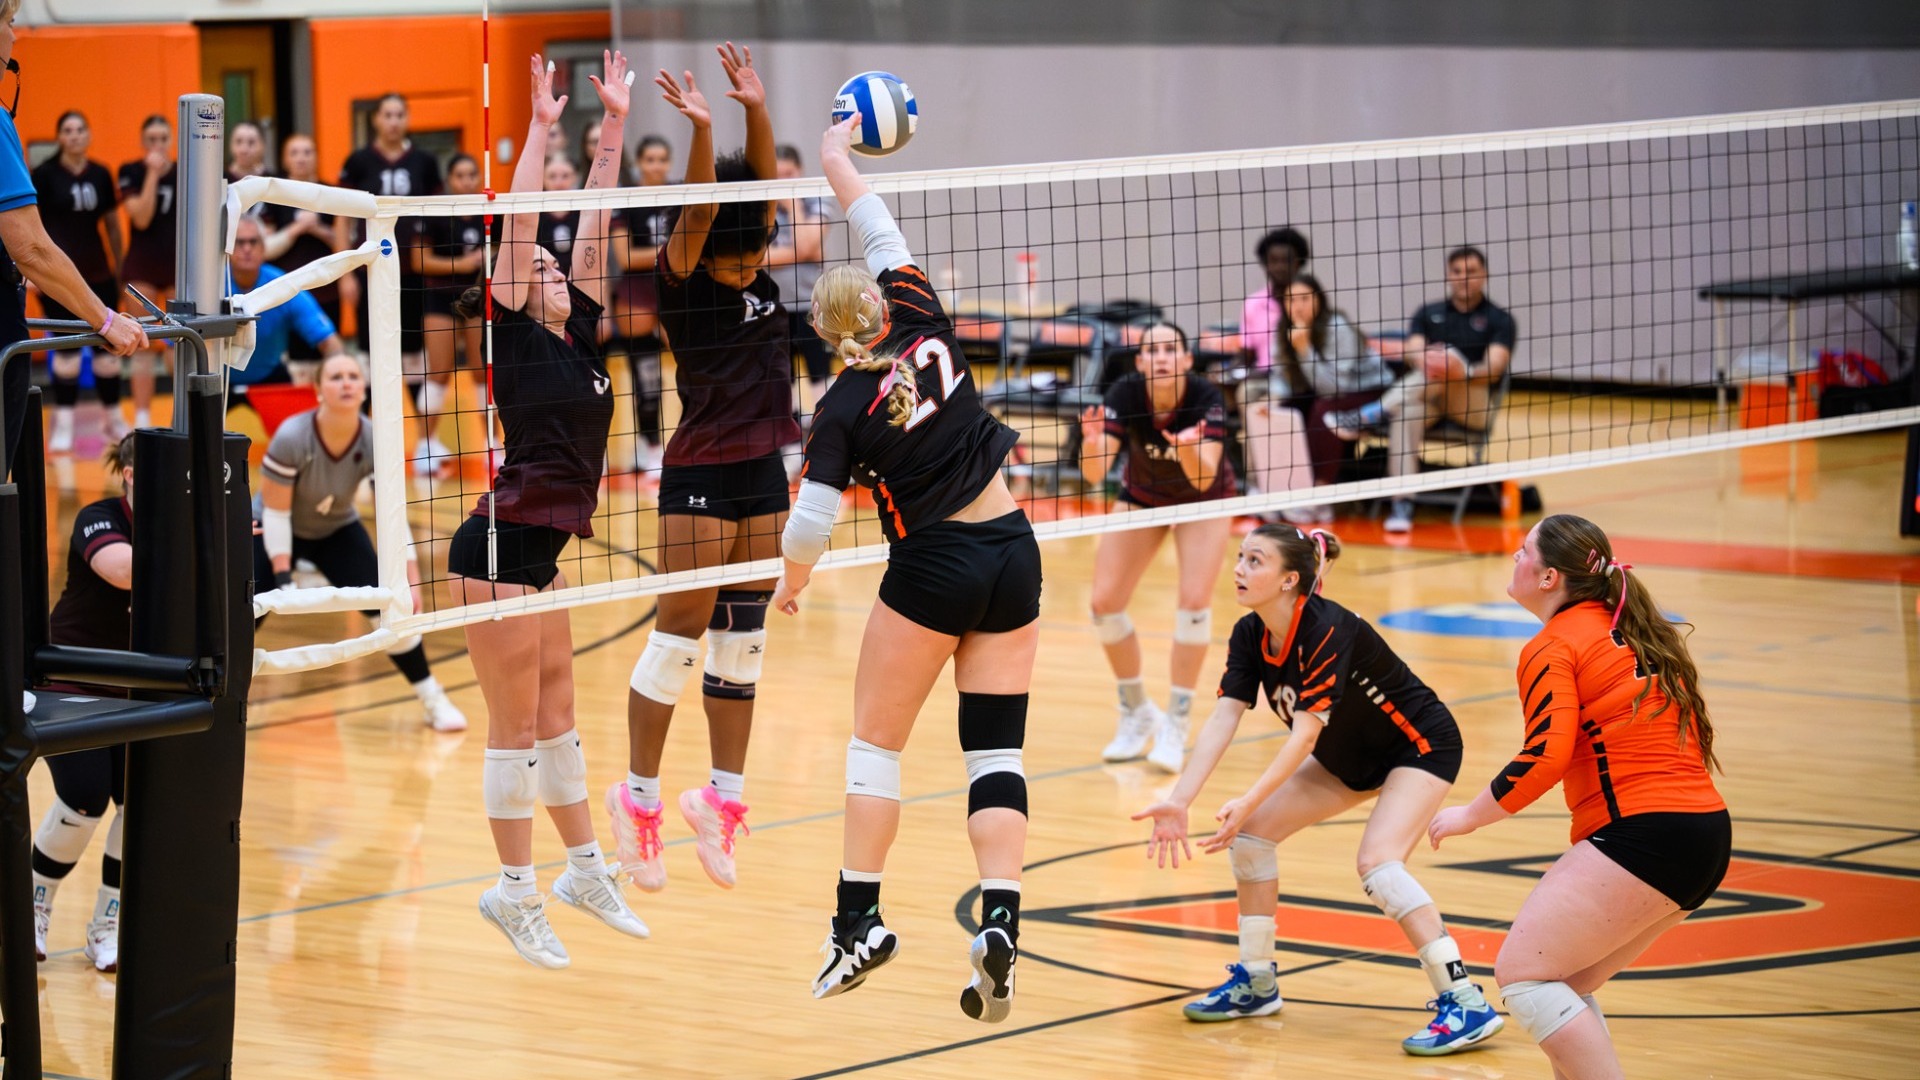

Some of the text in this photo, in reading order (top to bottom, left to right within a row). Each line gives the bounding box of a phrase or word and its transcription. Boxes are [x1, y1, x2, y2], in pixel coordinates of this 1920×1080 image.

[71, 182, 98, 212] 10
[878, 336, 966, 432] 22
[83, 521, 112, 538] BEARS
